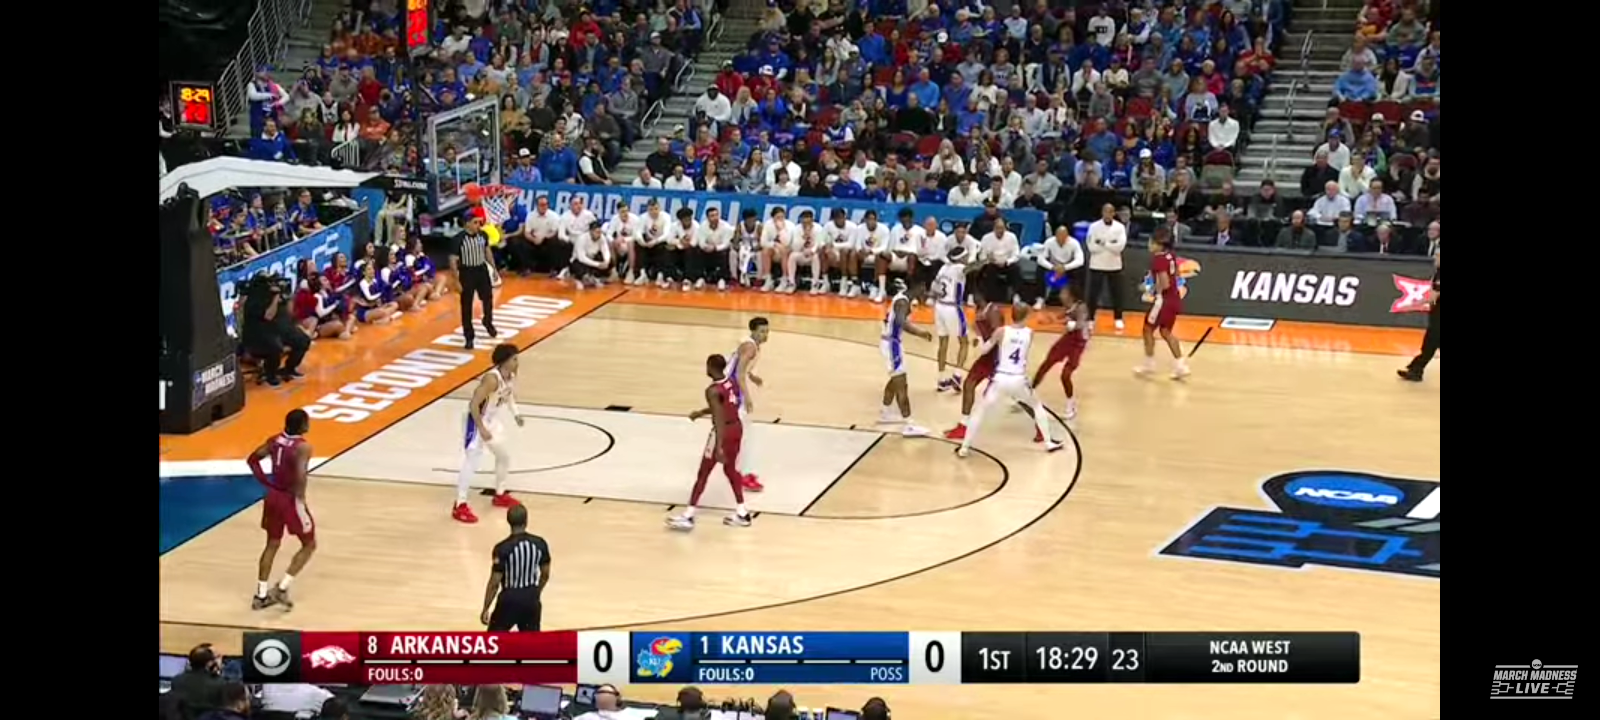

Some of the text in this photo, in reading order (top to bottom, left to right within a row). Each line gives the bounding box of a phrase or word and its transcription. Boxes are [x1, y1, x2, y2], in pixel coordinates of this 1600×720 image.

[1230, 270, 1360, 306] KANSAS
[1008, 347, 1021, 365] 4
[300, 348, 476, 424] SECOND
[276, 446, 283, 466] 1
[1294, 486, 1398, 505] NCAA
